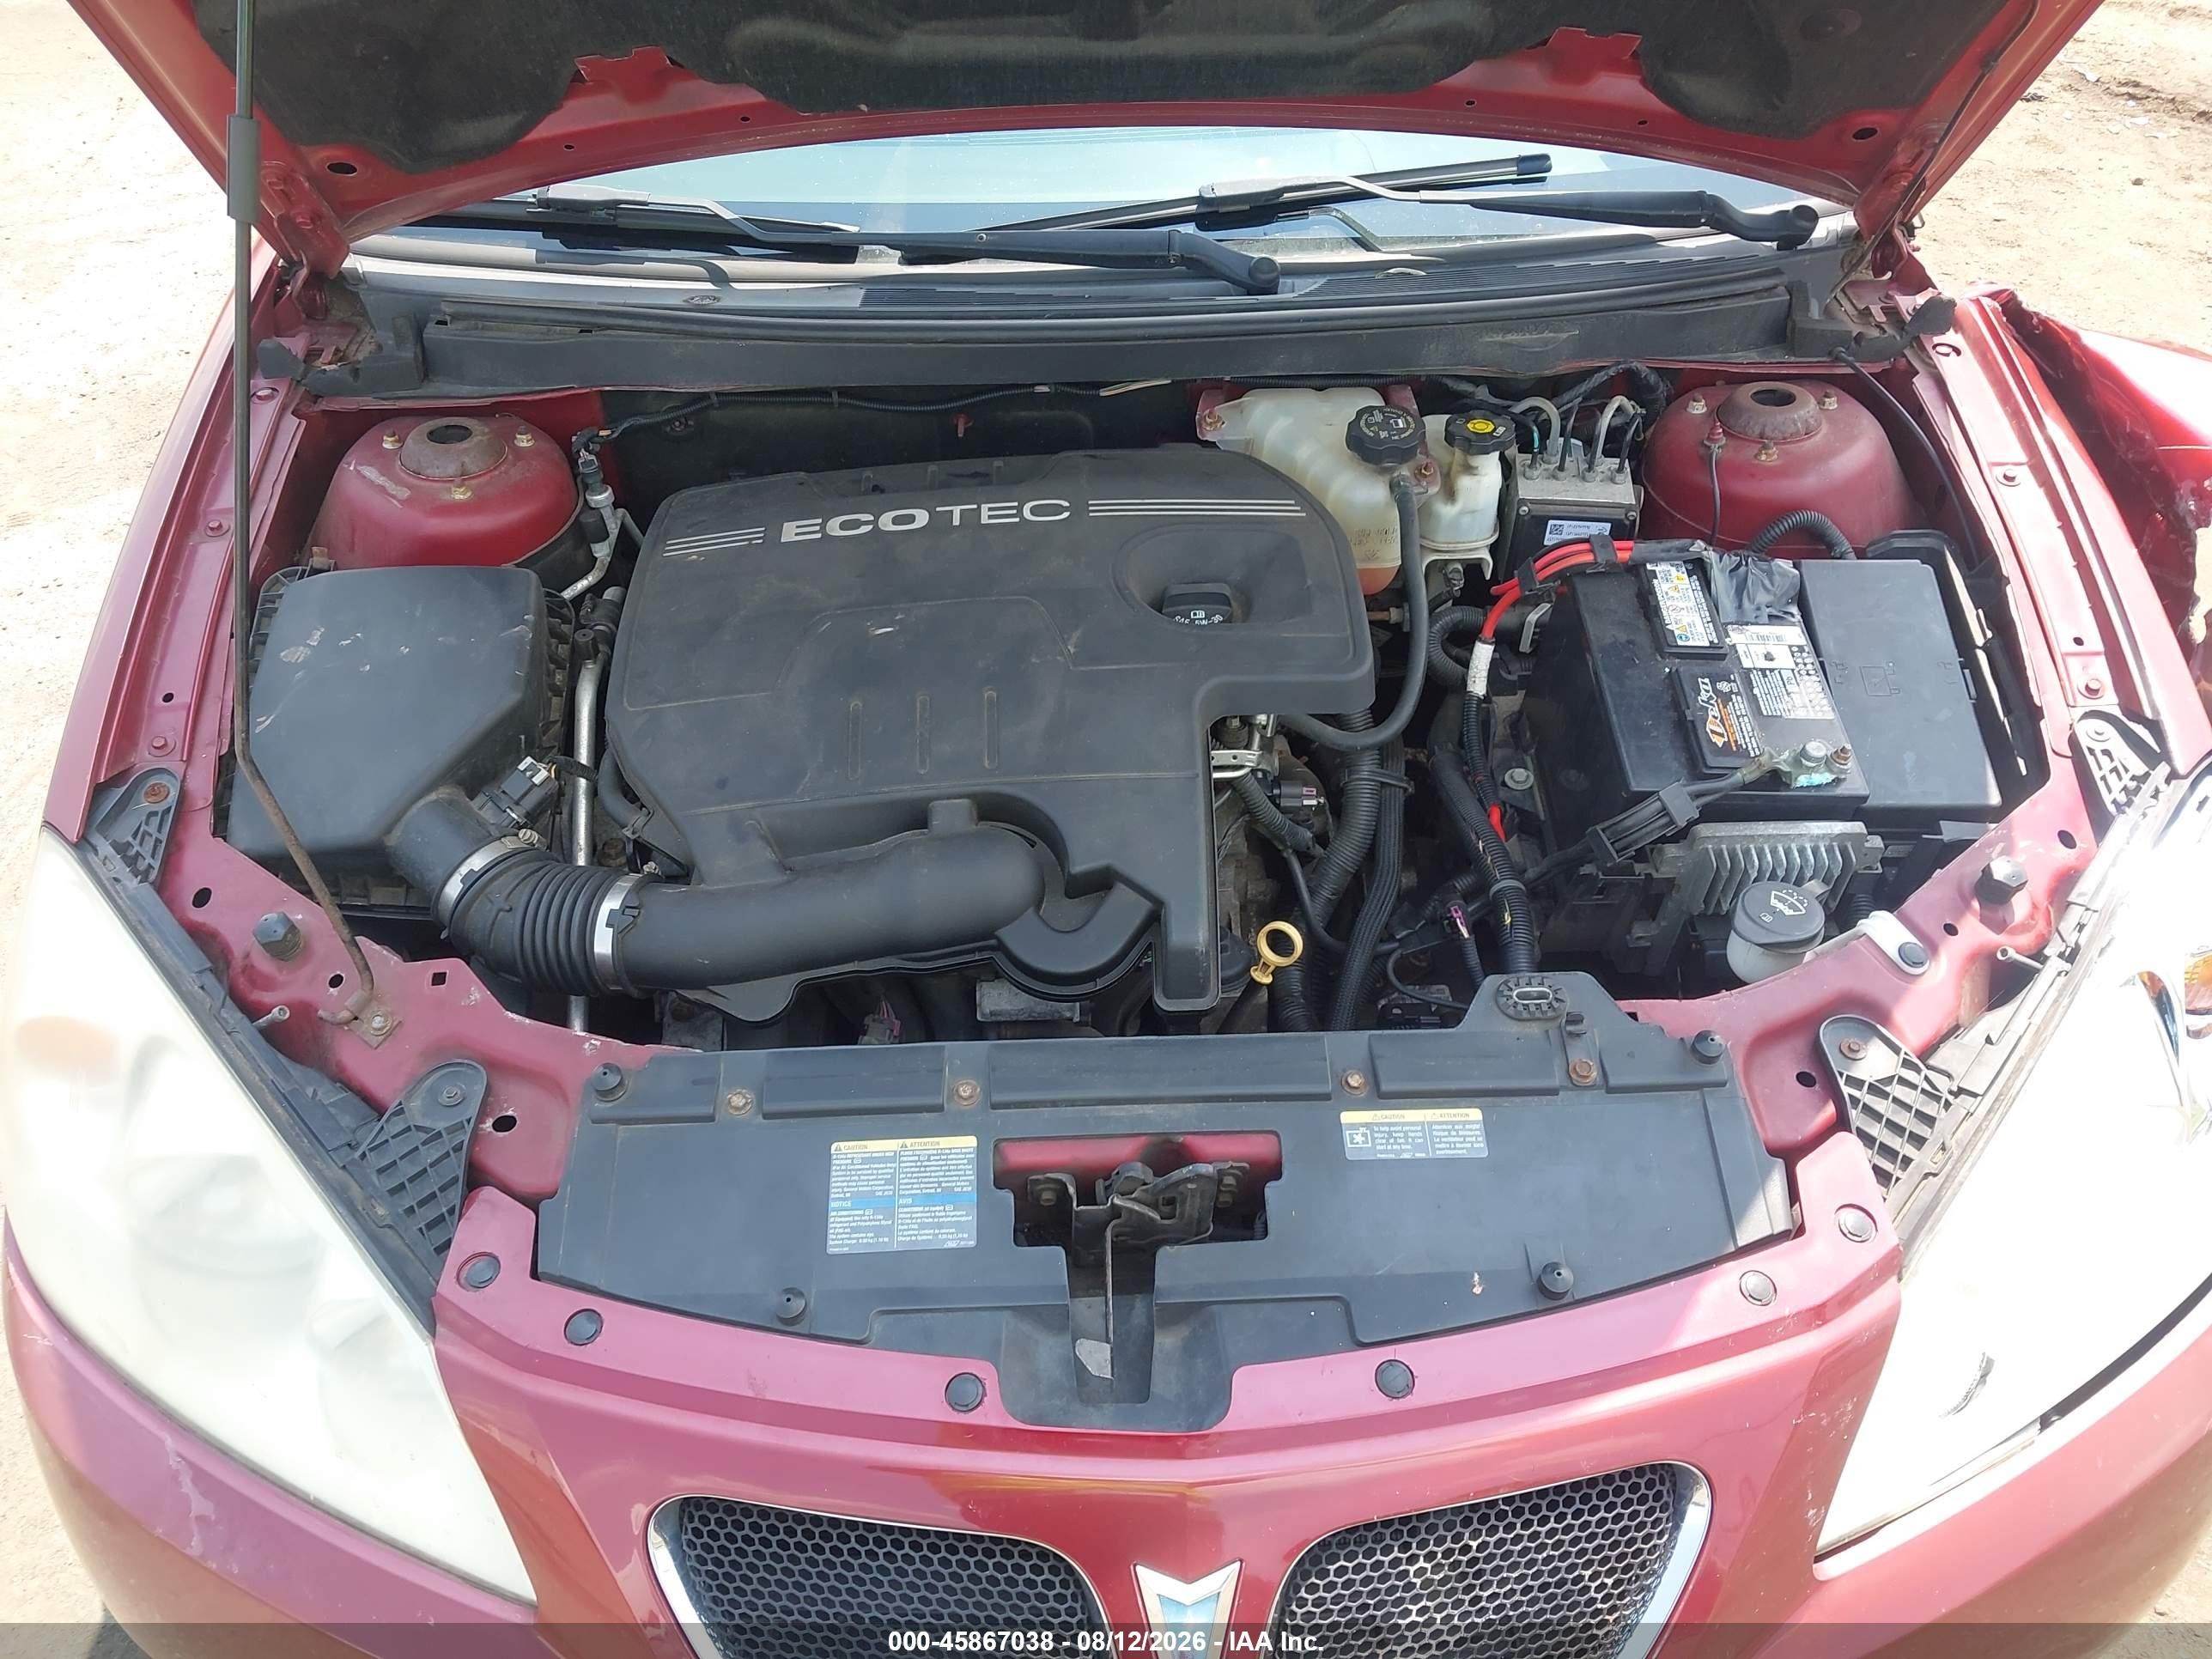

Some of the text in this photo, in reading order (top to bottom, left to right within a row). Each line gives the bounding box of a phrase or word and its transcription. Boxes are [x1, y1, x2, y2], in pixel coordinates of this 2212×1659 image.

[781, 499, 1071, 543] ECOTEC
[1785, 675, 1796, 687] Pb
[1697, 677, 1728, 748] Deka
